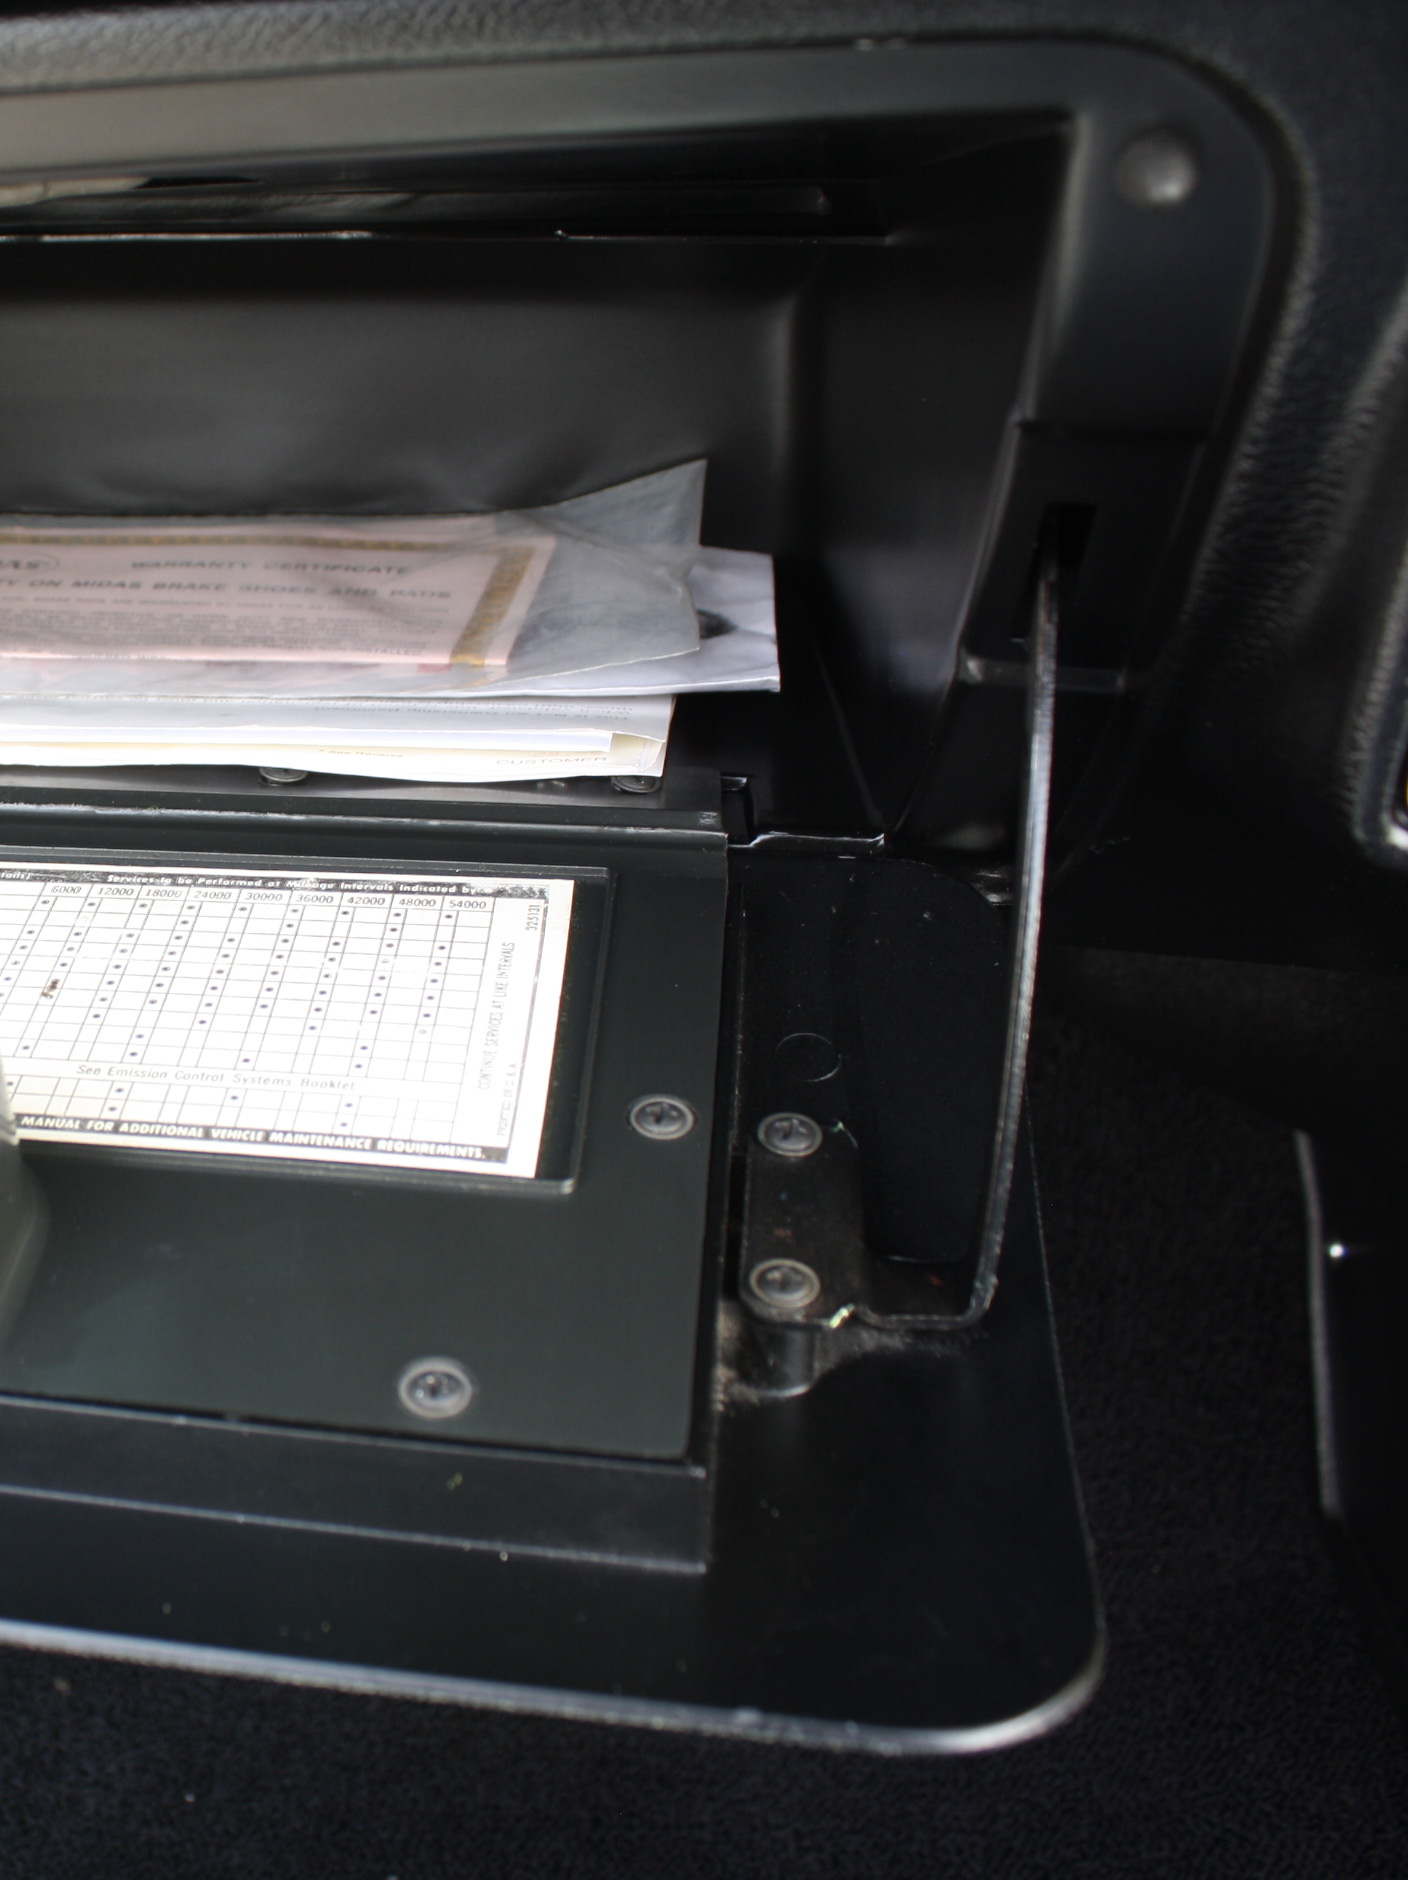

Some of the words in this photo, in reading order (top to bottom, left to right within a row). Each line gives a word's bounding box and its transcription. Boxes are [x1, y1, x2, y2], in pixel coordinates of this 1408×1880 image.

[496, 756, 608, 765] CUSTOMER
[107, 874, 156, 884] Services
[160, 876, 172, 885] to
[178, 876, 192, 885] be
[197, 877, 262, 888] Performed
[268, 880, 282, 888] at
[340, 882, 394, 891] Intervals
[399, 884, 456, 893] Indicated
[51, 885, 82, 894] 6000
[97, 887, 135, 896] 12000
[144, 889, 182, 898] 18000
[193, 890, 232, 900] 24000
[244, 892, 283, 902] 30000
[296, 894, 334, 904] 36000
[347, 897, 386, 905] 42000
[398, 898, 437, 907] 48000
[449, 900, 487, 909] 54000
[497, 942, 516, 980] INTERVALS
[494, 981, 509, 998] LIKE
[492, 999, 505, 1011] AT
[484, 1011, 503, 1048] SERVICES
[76, 1064, 102, 1075] See
[106, 1066, 168, 1079] Emission
[174, 1070, 225, 1082] Control
[232, 1073, 292, 1087] Systems
[300, 1078, 355, 1090] Booklet
[21, 1115, 81, 1130] MANUAL
[86, 1120, 114, 1131] FOR
[119, 1122, 204, 1138] ADDITIONAL
[211, 1128, 264, 1141] VEHICLE
[269, 1130, 372, 1150] MAINTENANCE
[376, 1138, 486, 1160] REQUIREMENTS.
